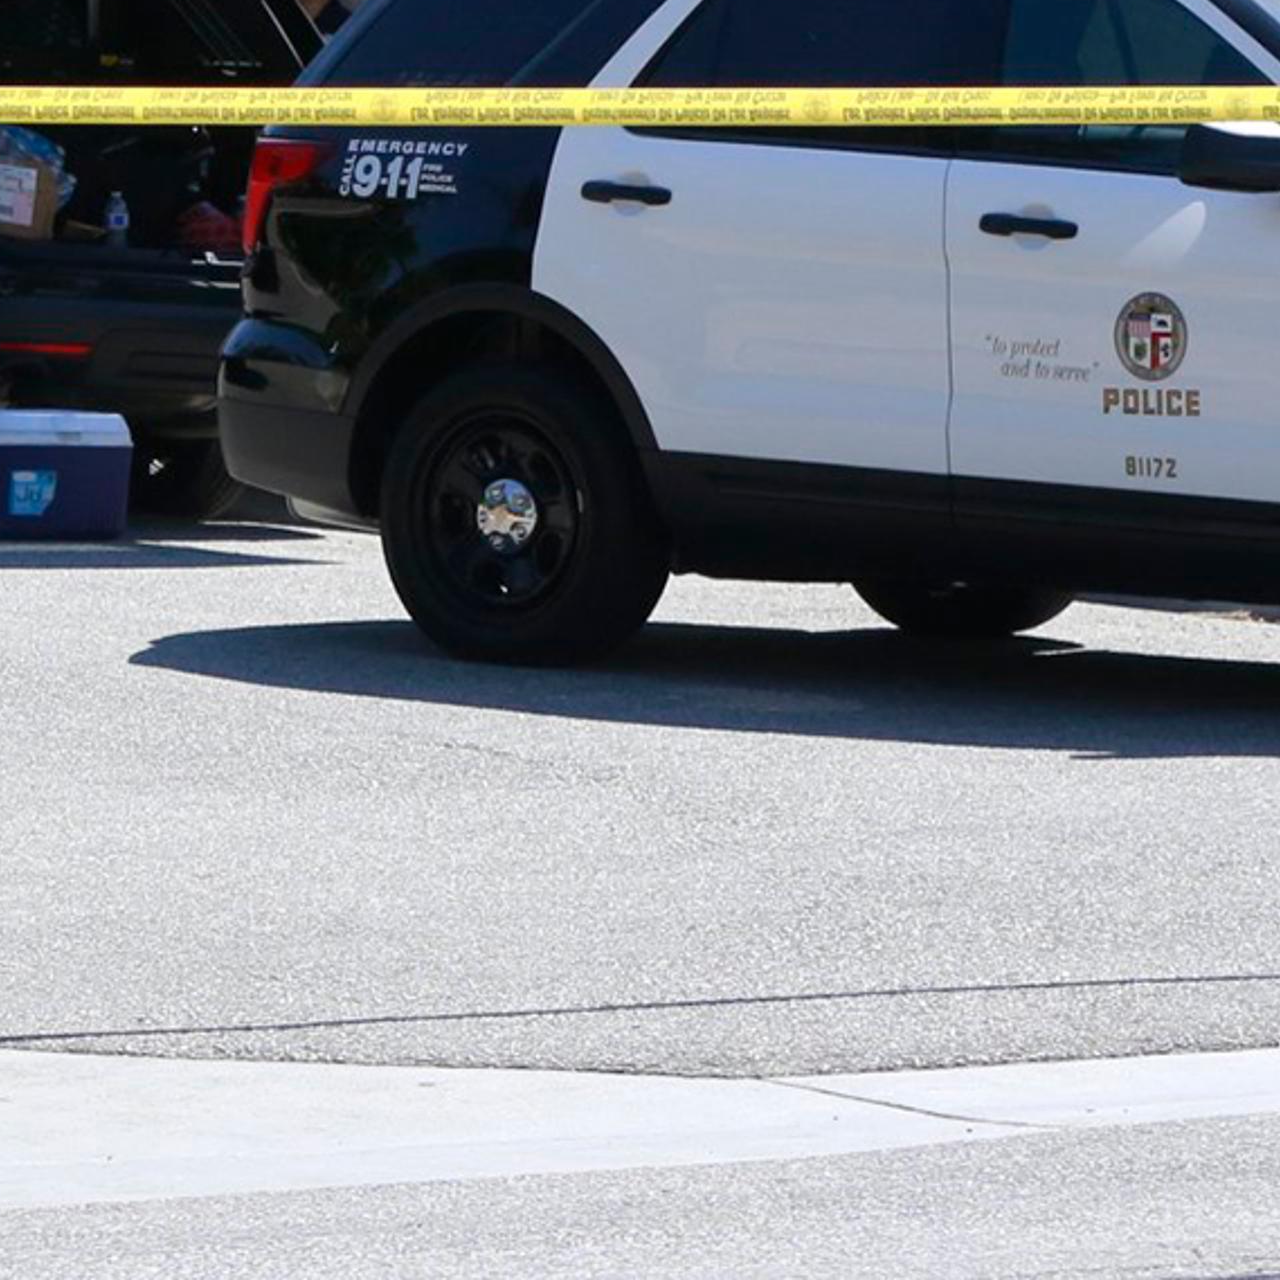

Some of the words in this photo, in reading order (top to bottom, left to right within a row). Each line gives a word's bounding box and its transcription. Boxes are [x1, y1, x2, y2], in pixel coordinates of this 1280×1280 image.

[348, 139, 468, 157] EMERGENCY
[339, 154, 357, 197] CALL
[1000, 357, 1030, 378] and
[1102, 387, 1201, 417] POLICE
[1125, 455, 1177, 478] 81172
